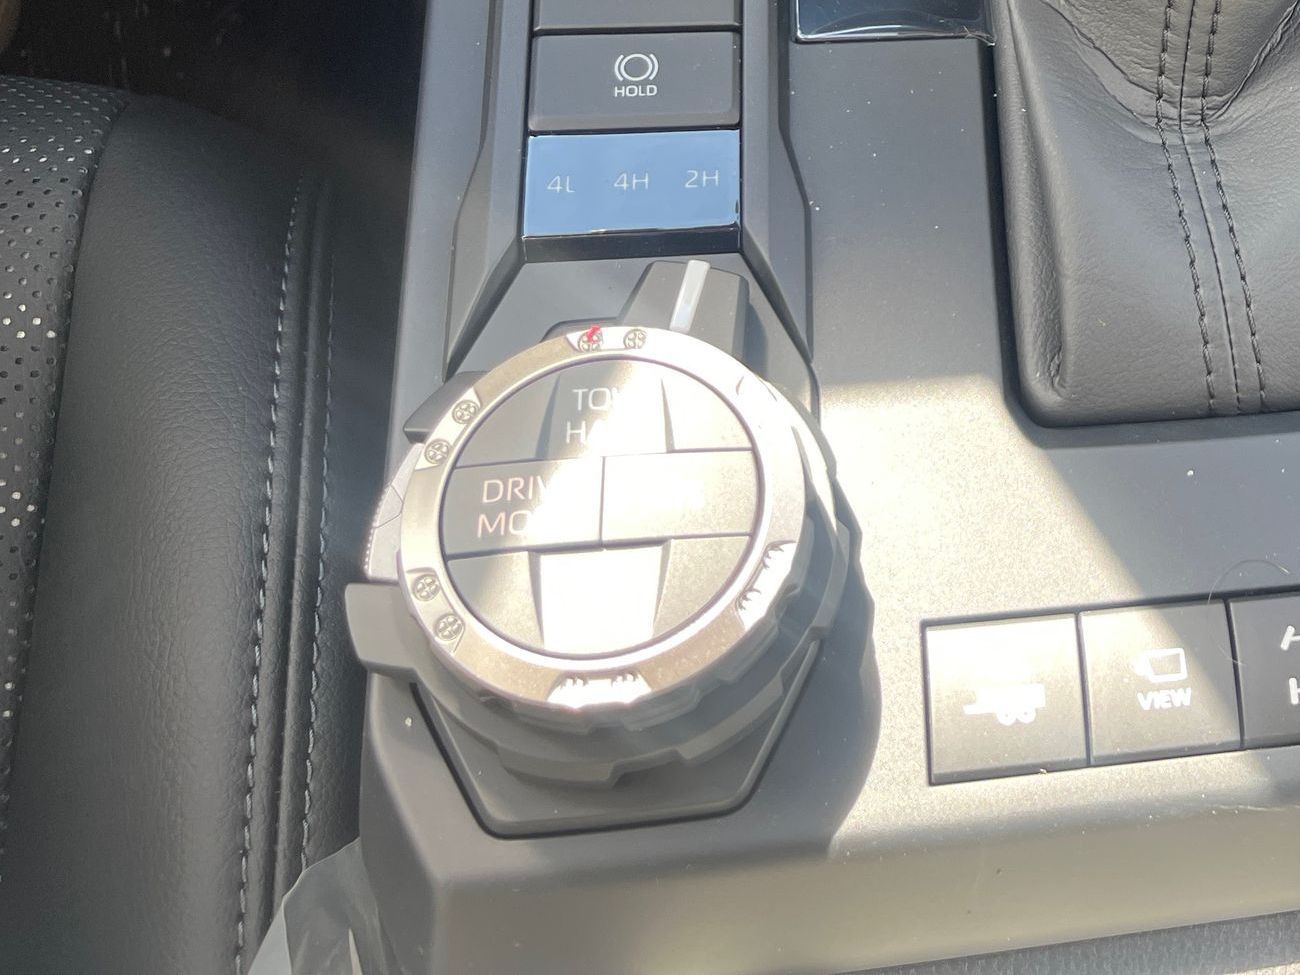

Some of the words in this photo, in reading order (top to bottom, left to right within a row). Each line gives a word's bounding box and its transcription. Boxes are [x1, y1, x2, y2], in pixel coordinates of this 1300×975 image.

[614, 85, 658, 97] HOLD
[547, 175, 575, 194] 4L
[614, 172, 649, 191] 4H
[684, 170, 719, 189] 2H
[572, 387, 620, 411] TO
[1136, 687, 1192, 711] VIEW
